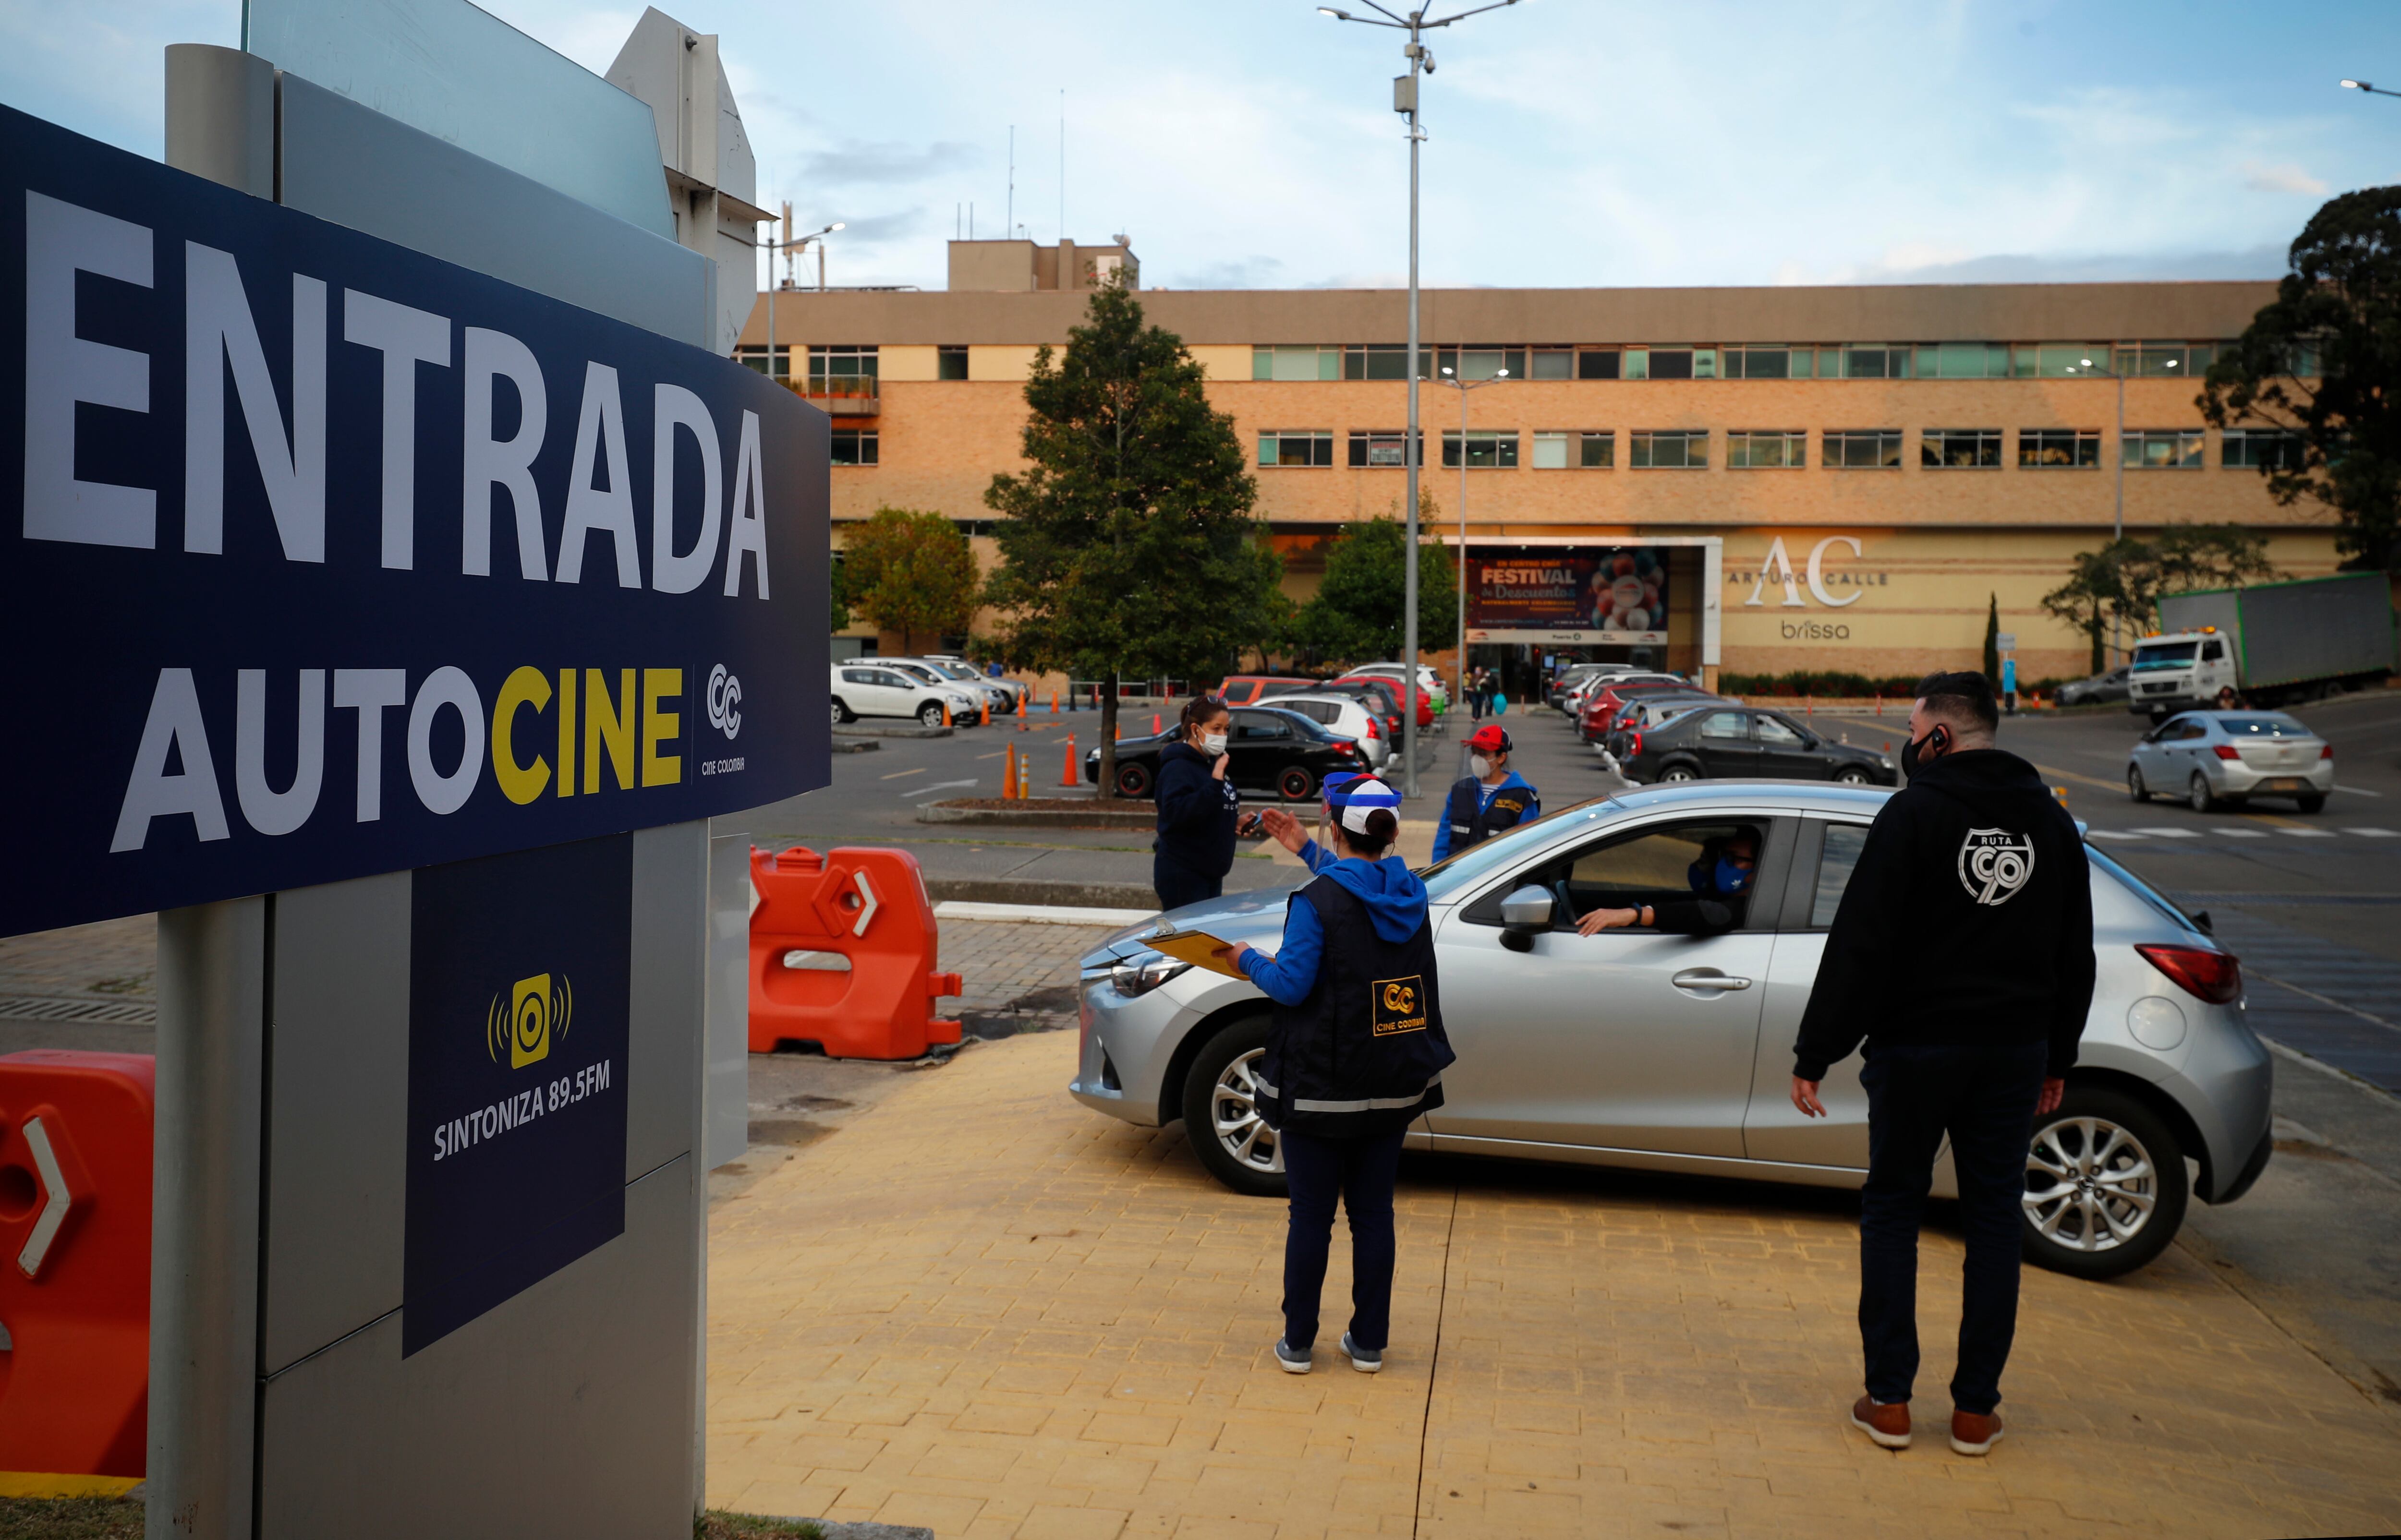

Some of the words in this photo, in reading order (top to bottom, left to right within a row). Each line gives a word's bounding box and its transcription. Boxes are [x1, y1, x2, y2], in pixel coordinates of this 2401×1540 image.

[23, 189, 769, 601] ENTRADA
[1481, 568, 1576, 584] FESTIVAL
[1729, 572, 1808, 585] ARTURO
[1826, 573, 1888, 585] CALLE
[1745, 535, 1863, 607] AC
[1495, 584, 1576, 599] Descuentos
[1782, 620, 1850, 639] brissa
[109, 665, 683, 854] AUTOCINE
[702, 760, 716, 776] CINE
[717, 757, 744, 774] COLOMBIA
[1981, 837, 2012, 845] RUTA
[1377, 1023, 1396, 1032] CINE
[434, 1086, 544, 1161] SINTONIZA
[548, 1059, 610, 1112] 89.5FM
